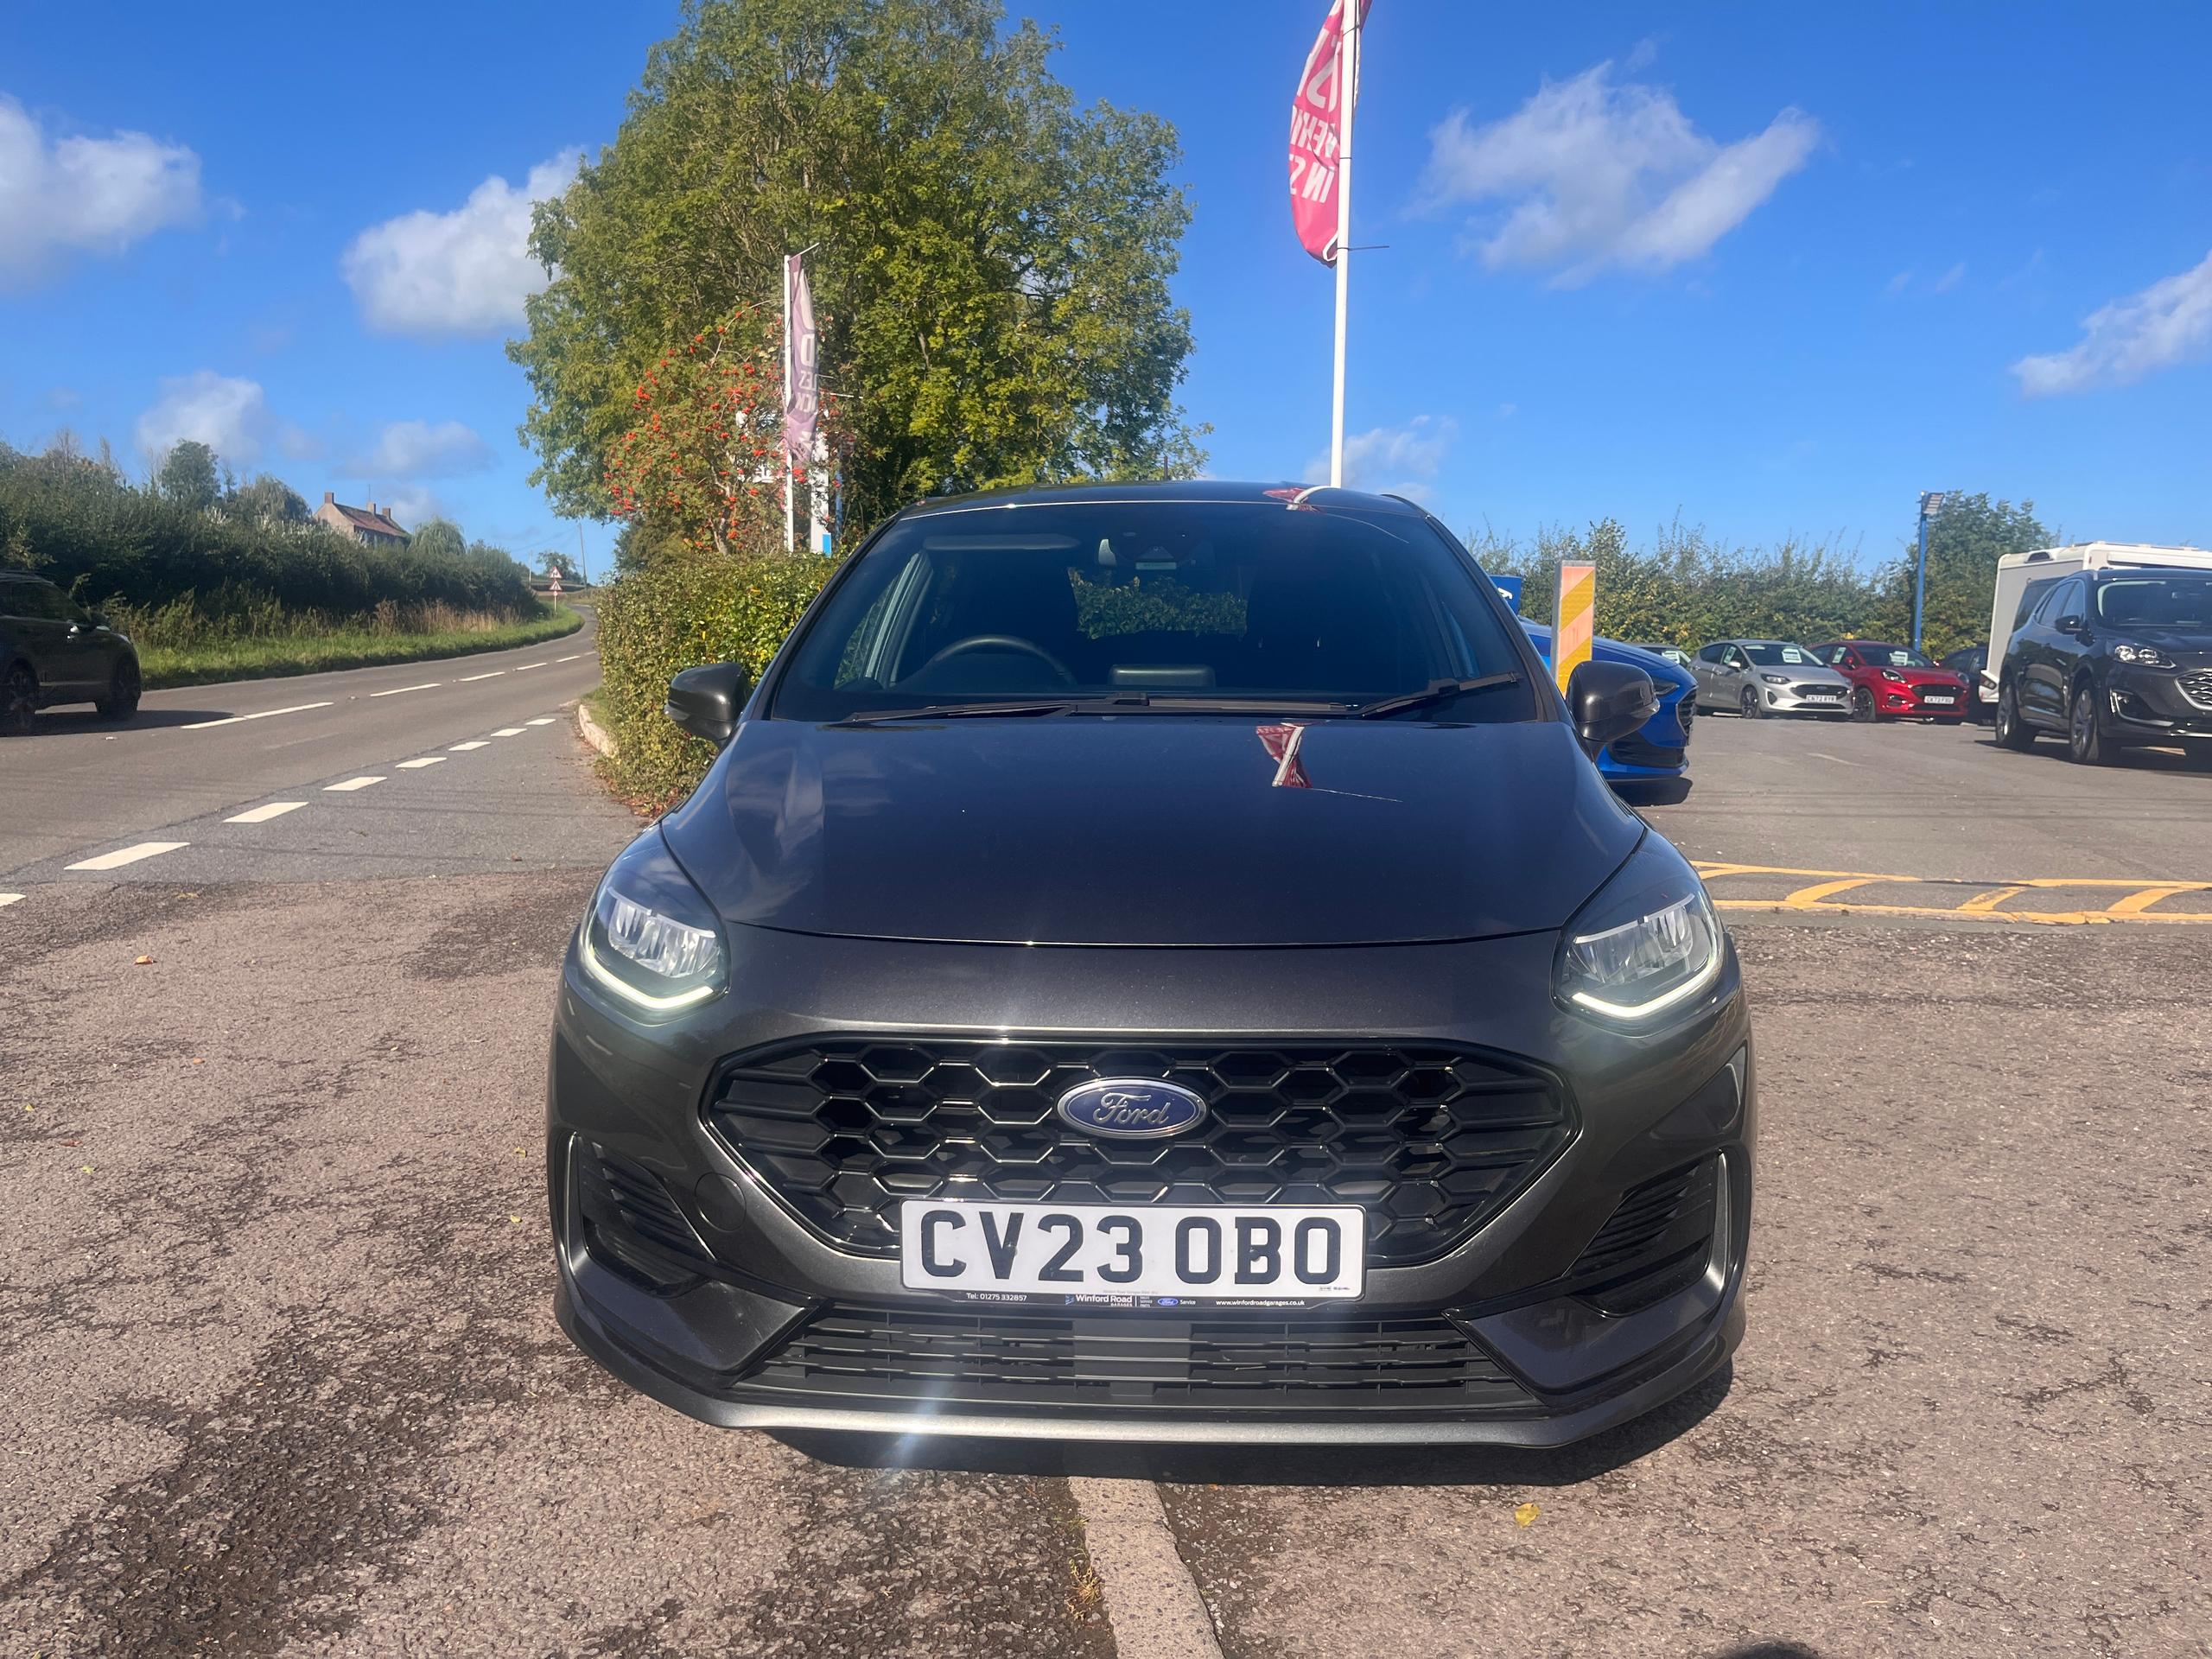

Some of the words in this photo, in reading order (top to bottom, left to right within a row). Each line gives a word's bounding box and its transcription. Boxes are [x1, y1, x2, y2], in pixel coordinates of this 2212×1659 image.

[1092, 1091, 1172, 1125] Ford
[920, 1210, 1143, 1284] CV23
[1174, 1215, 1341, 1286] OBO
